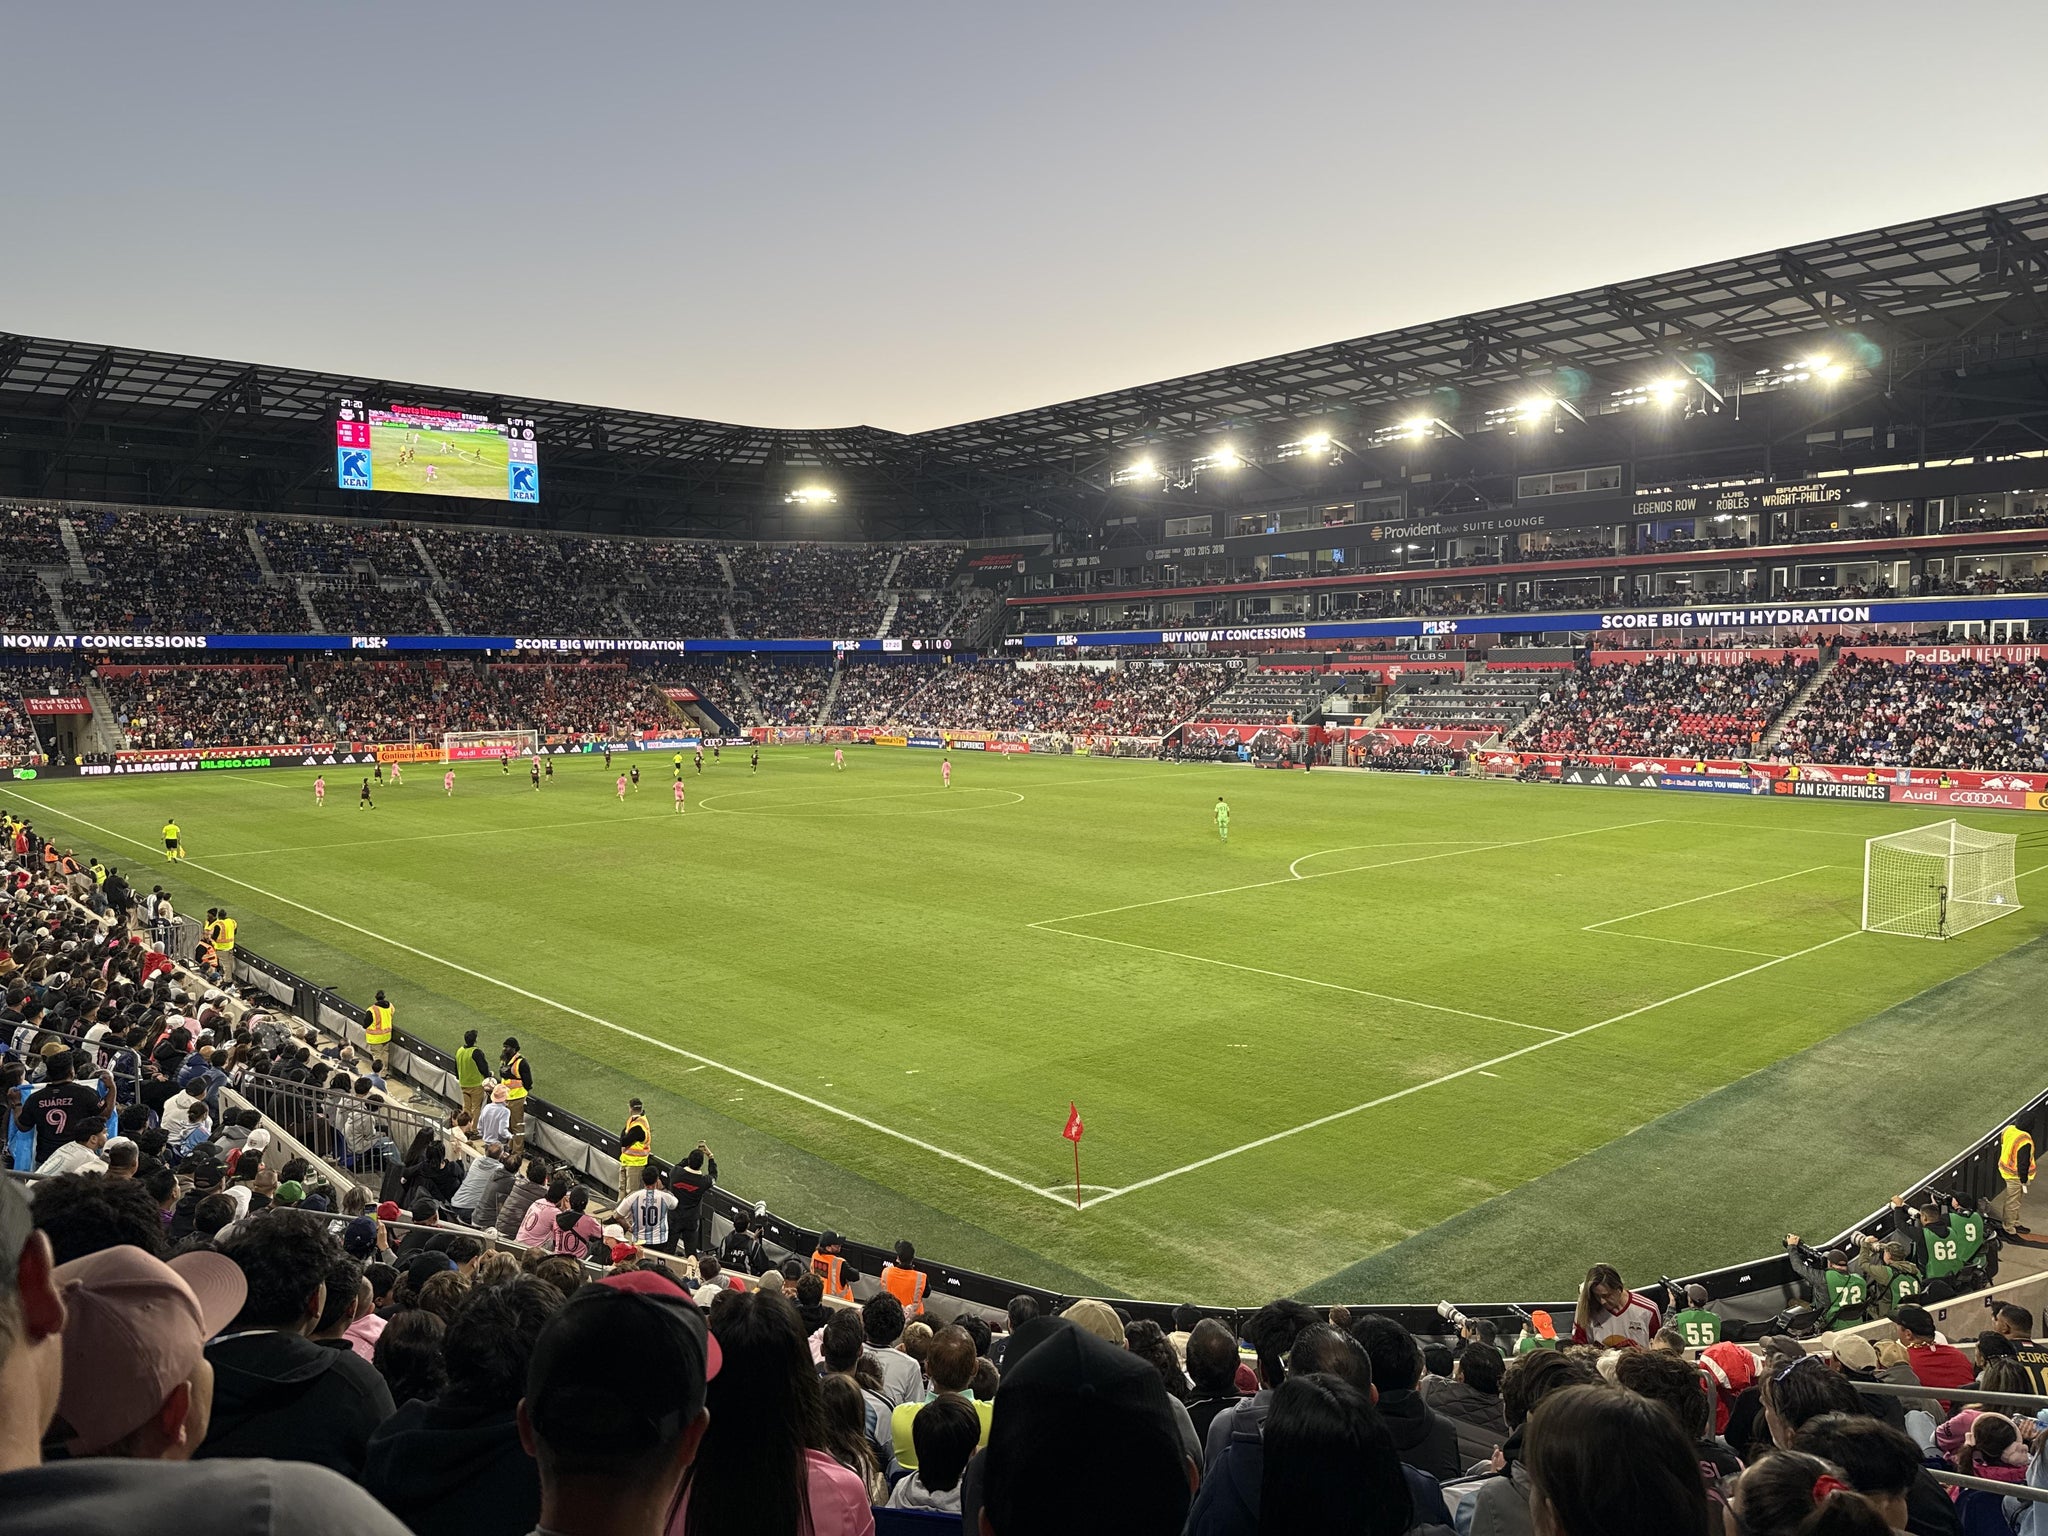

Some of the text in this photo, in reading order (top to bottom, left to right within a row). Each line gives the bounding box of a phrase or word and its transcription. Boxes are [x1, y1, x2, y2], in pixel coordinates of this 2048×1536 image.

[391, 404, 419, 414] Sports
[462, 413, 488, 422] STADIUM
[343, 478, 368, 487] KEAN
[1776, 484, 1827, 494] BRADLEY
[514, 492, 535, 500] KEAN
[1762, 489, 1841, 506] WRIGHT-PHILLIPS
[1633, 498, 1749, 515] LEGENDS ROW ROBLES
[1384, 522, 1441, 539] Provident
[1463, 521, 1494, 531] SUITE
[1498, 516, 1545, 528] LOUNGE
[1198, 546, 1210, 555] 2015
[1601, 606, 1870, 629] SCORE BIG WITH HYDRATION
[4, 635, 206, 648] NOW AT CONCESSIONS
[1162, 627, 1306, 643] BUY NOW AT CONCESSIONS
[515, 639, 684, 651] SCORE BIG WITH HYDRATION
[1702, 652, 1720, 665] NEW
[1905, 648, 2041, 662] Red Bull NEW YORK
[382, 750, 422, 761] Continental
[80, 758, 271, 775] FIND A LEAGUE AT MLSGO.COM
[1775, 782, 1885, 799] SI FAN EXPERIENCES
[1902, 789, 1938, 801] Audi
[39, 1096, 73, 1108] SUÁREZ
[46, 1108, 67, 1134] 9
[641, 1206, 658, 1226] 10
[557, 1230, 579, 1252] 10
[1964, 1223, 1976, 1242] 9
[1934, 1240, 1956, 1261] 62
[1836, 1286, 1862, 1307] 72
[1898, 1280, 1920, 1297] 61
[1686, 1323, 1714, 1345] 55
